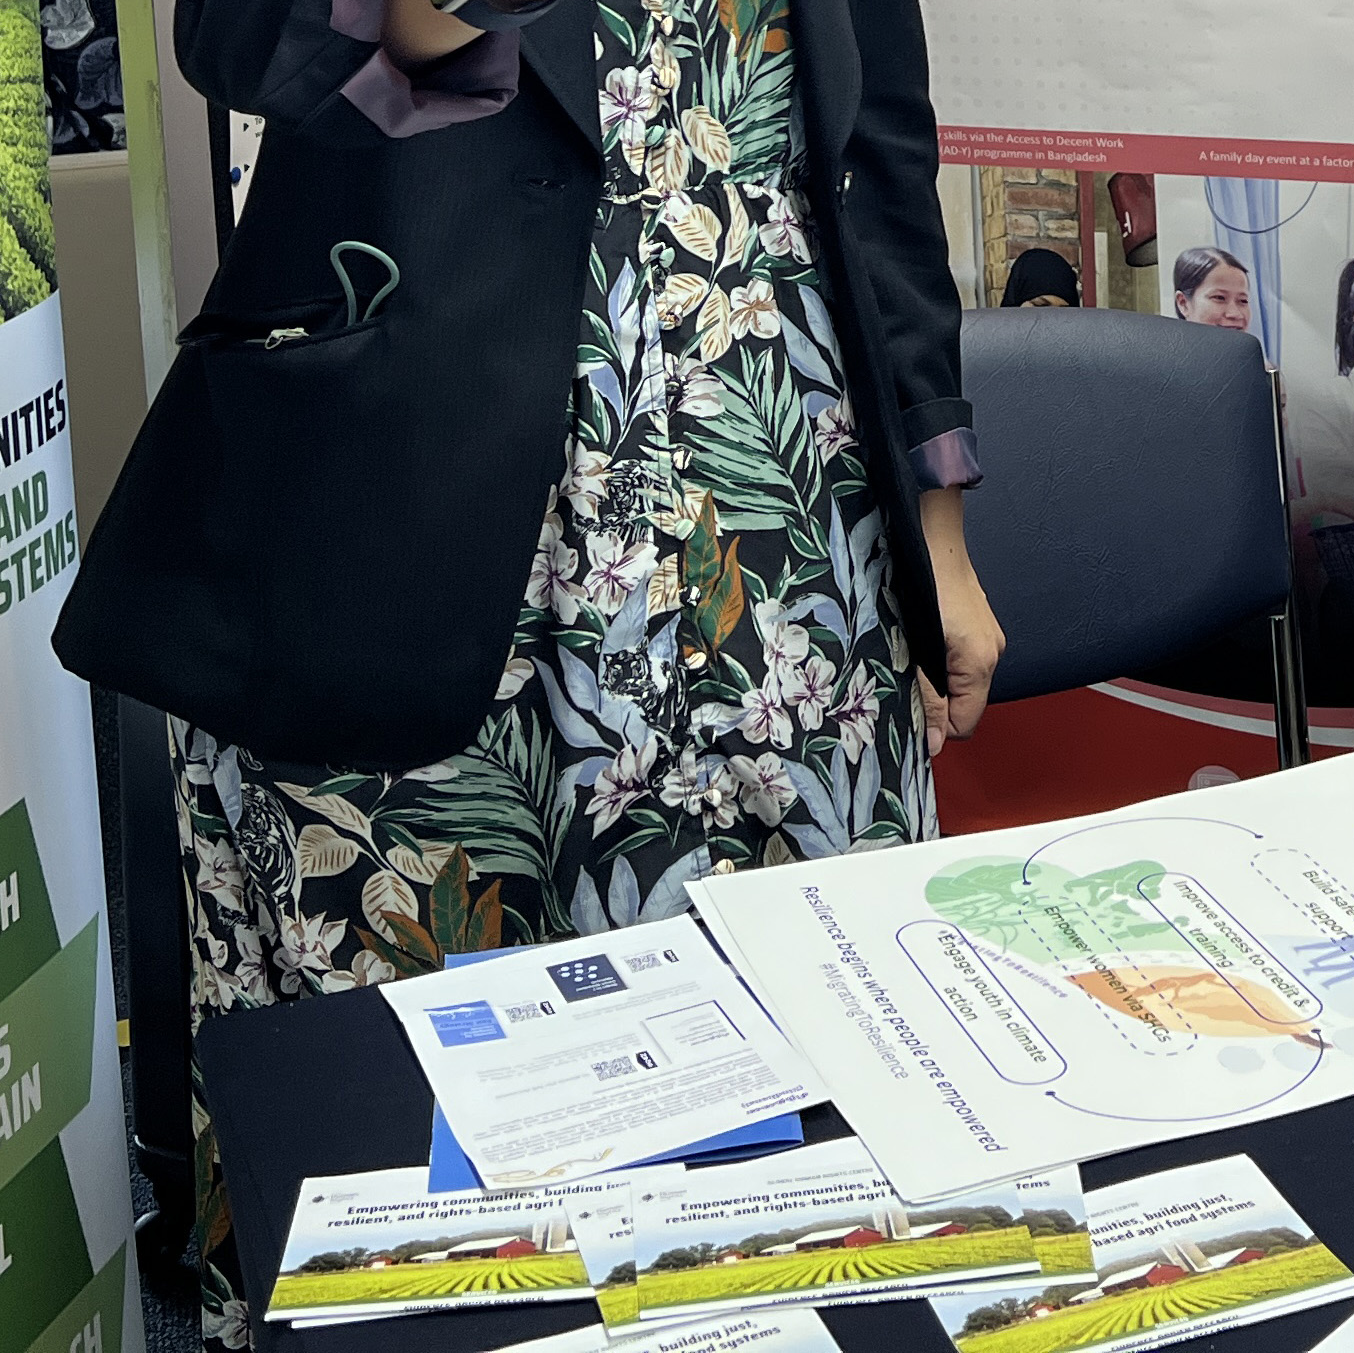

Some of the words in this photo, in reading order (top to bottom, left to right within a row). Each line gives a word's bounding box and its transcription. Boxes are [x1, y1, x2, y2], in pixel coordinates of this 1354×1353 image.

[943, 130, 968, 141] skills
[969, 131, 984, 142] via
[986, 132, 1004, 143] the
[1005, 133, 1041, 145] Access
[1042, 135, 1054, 145] to
[1056, 135, 1093, 147] Decent
[1094, 137, 1124, 148] Work
[973, 148, 1033, 160] programme
[1034, 150, 1046, 160] in
[1047, 150, 1107, 164] Bangladesh
[1198, 150, 1208, 161] A
[1209, 150, 1242, 165] family
[1244, 152, 1265, 166] day
[1266, 155, 1297, 165] event
[1299, 156, 1311, 166] at
[1312, 157, 1320, 166] a
[800, 886, 846, 941] Resilience
[836, 942, 872, 979] begins
[862, 979, 898, 1015] where
[882, 1017, 929, 1057] people
[918, 1059, 945, 1079] are
[935, 1081, 1008, 1152] empowered
